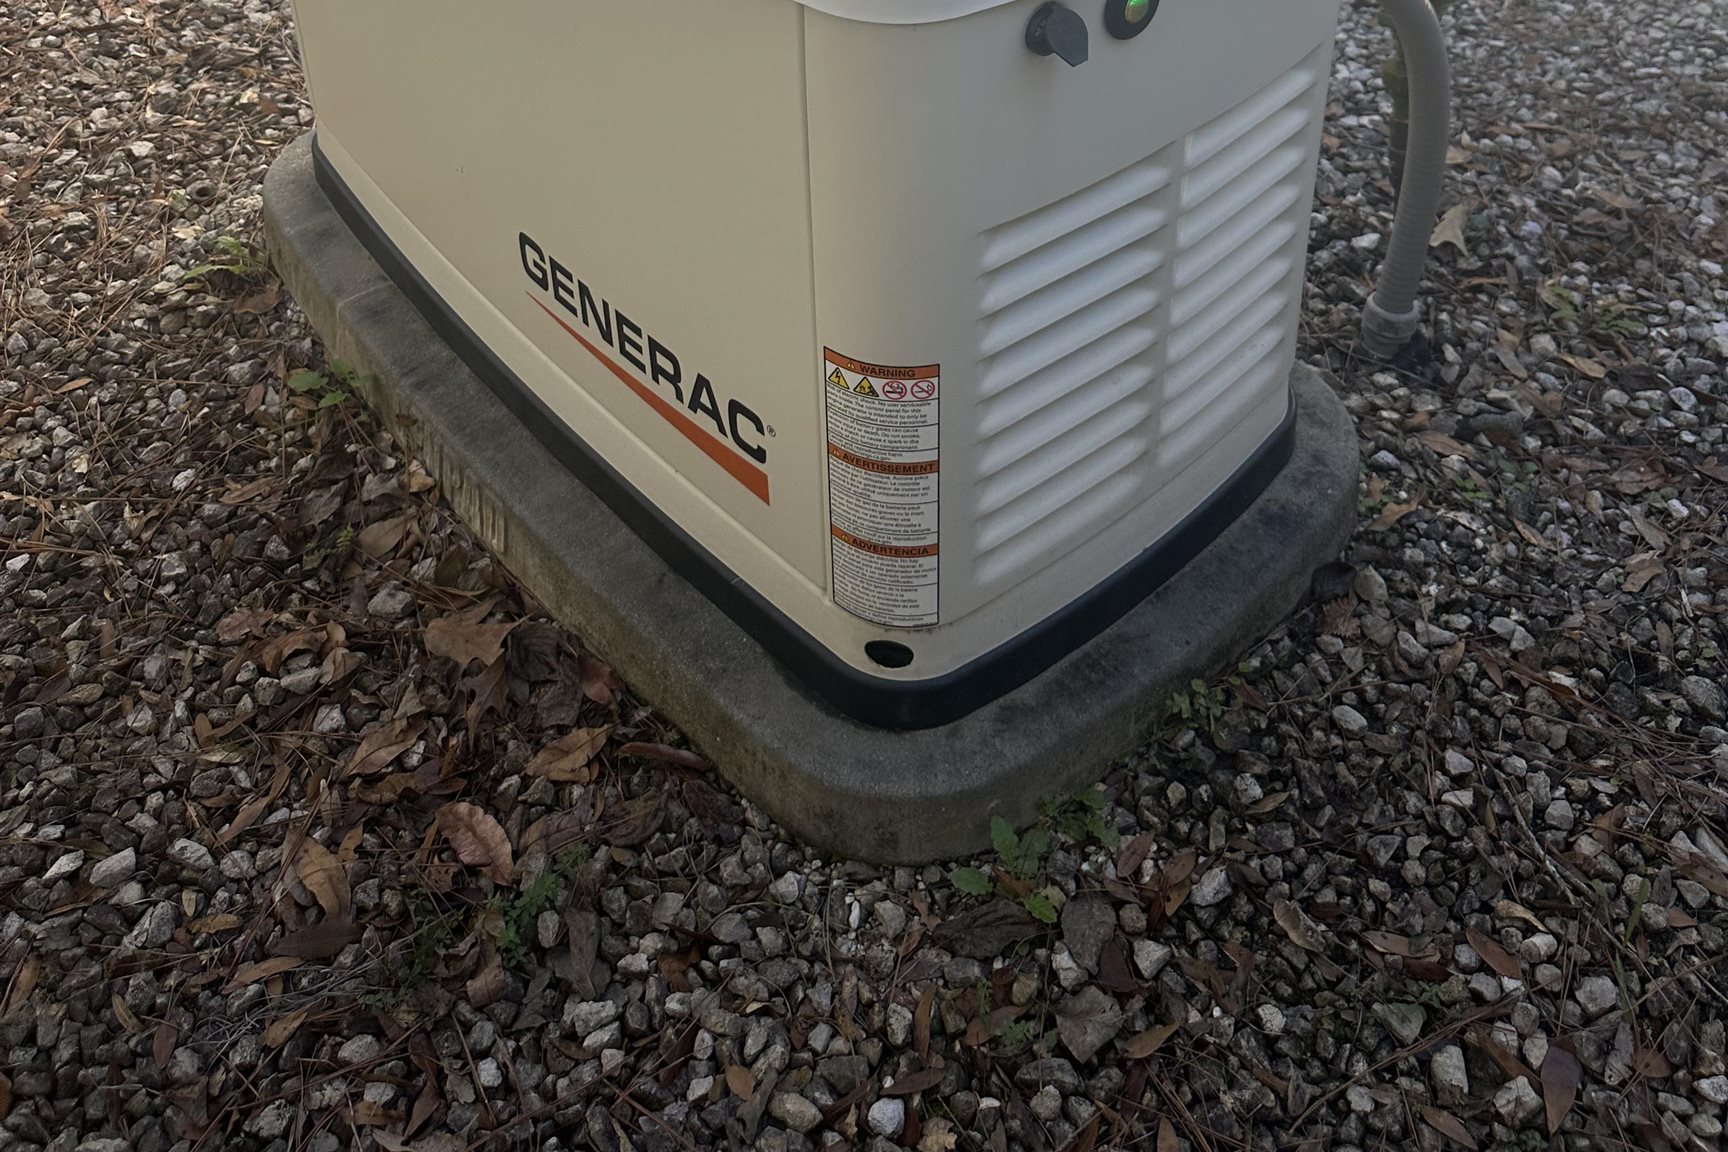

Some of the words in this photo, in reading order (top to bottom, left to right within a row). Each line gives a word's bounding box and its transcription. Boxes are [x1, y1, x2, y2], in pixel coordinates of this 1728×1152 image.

[859, 365, 916, 378] WARNING
[843, 453, 936, 474] AVERTISSEMENT
[851, 538, 929, 556] ADVERTENCIA
